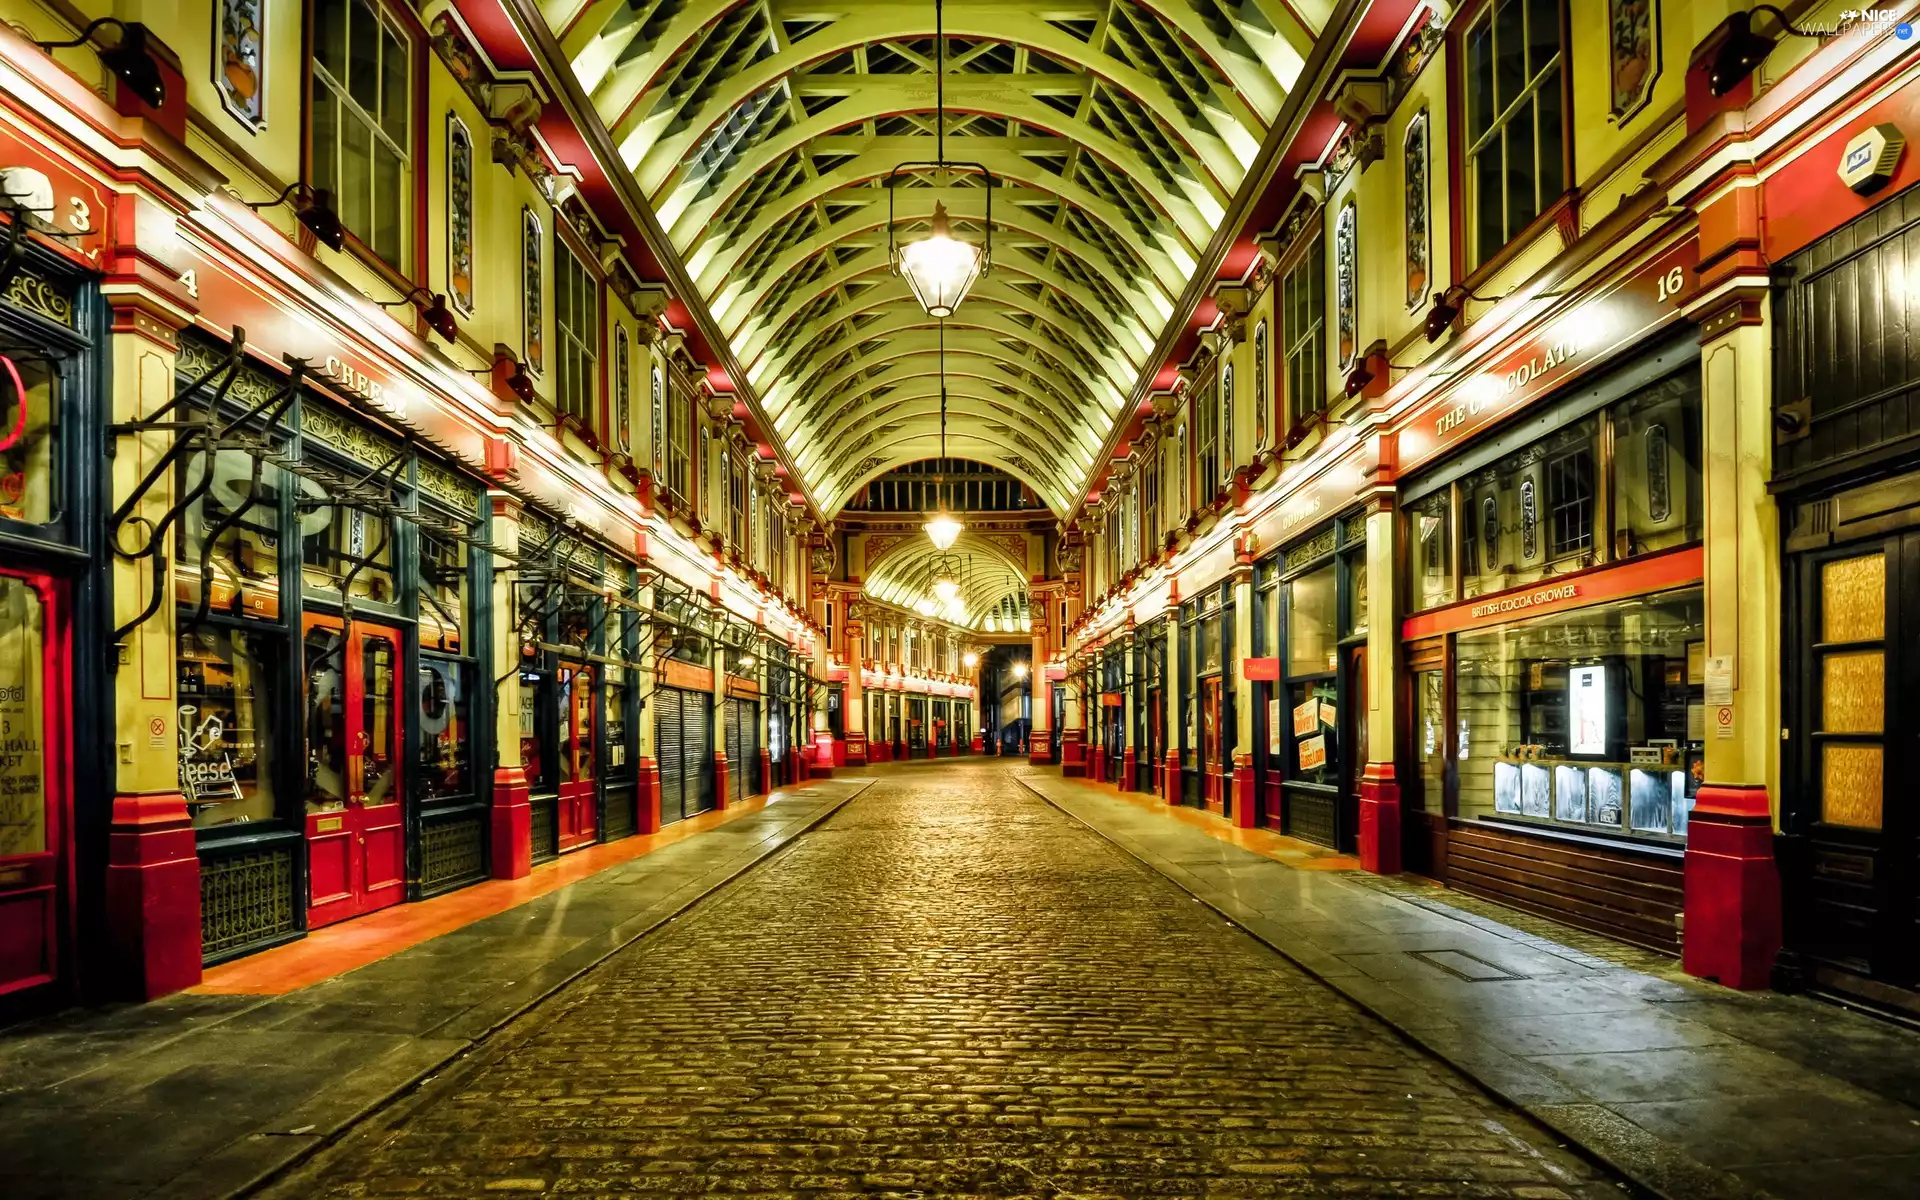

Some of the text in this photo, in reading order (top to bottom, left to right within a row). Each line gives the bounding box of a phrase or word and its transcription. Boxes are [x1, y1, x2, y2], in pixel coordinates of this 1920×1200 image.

[69, 196, 91, 232] 3
[179, 268, 198, 298] 4
[1657, 265, 1684, 303] 16
[1435, 404, 1466, 437] THE
[1471, 585, 1576, 618] BRITISH COCOA GROWER
